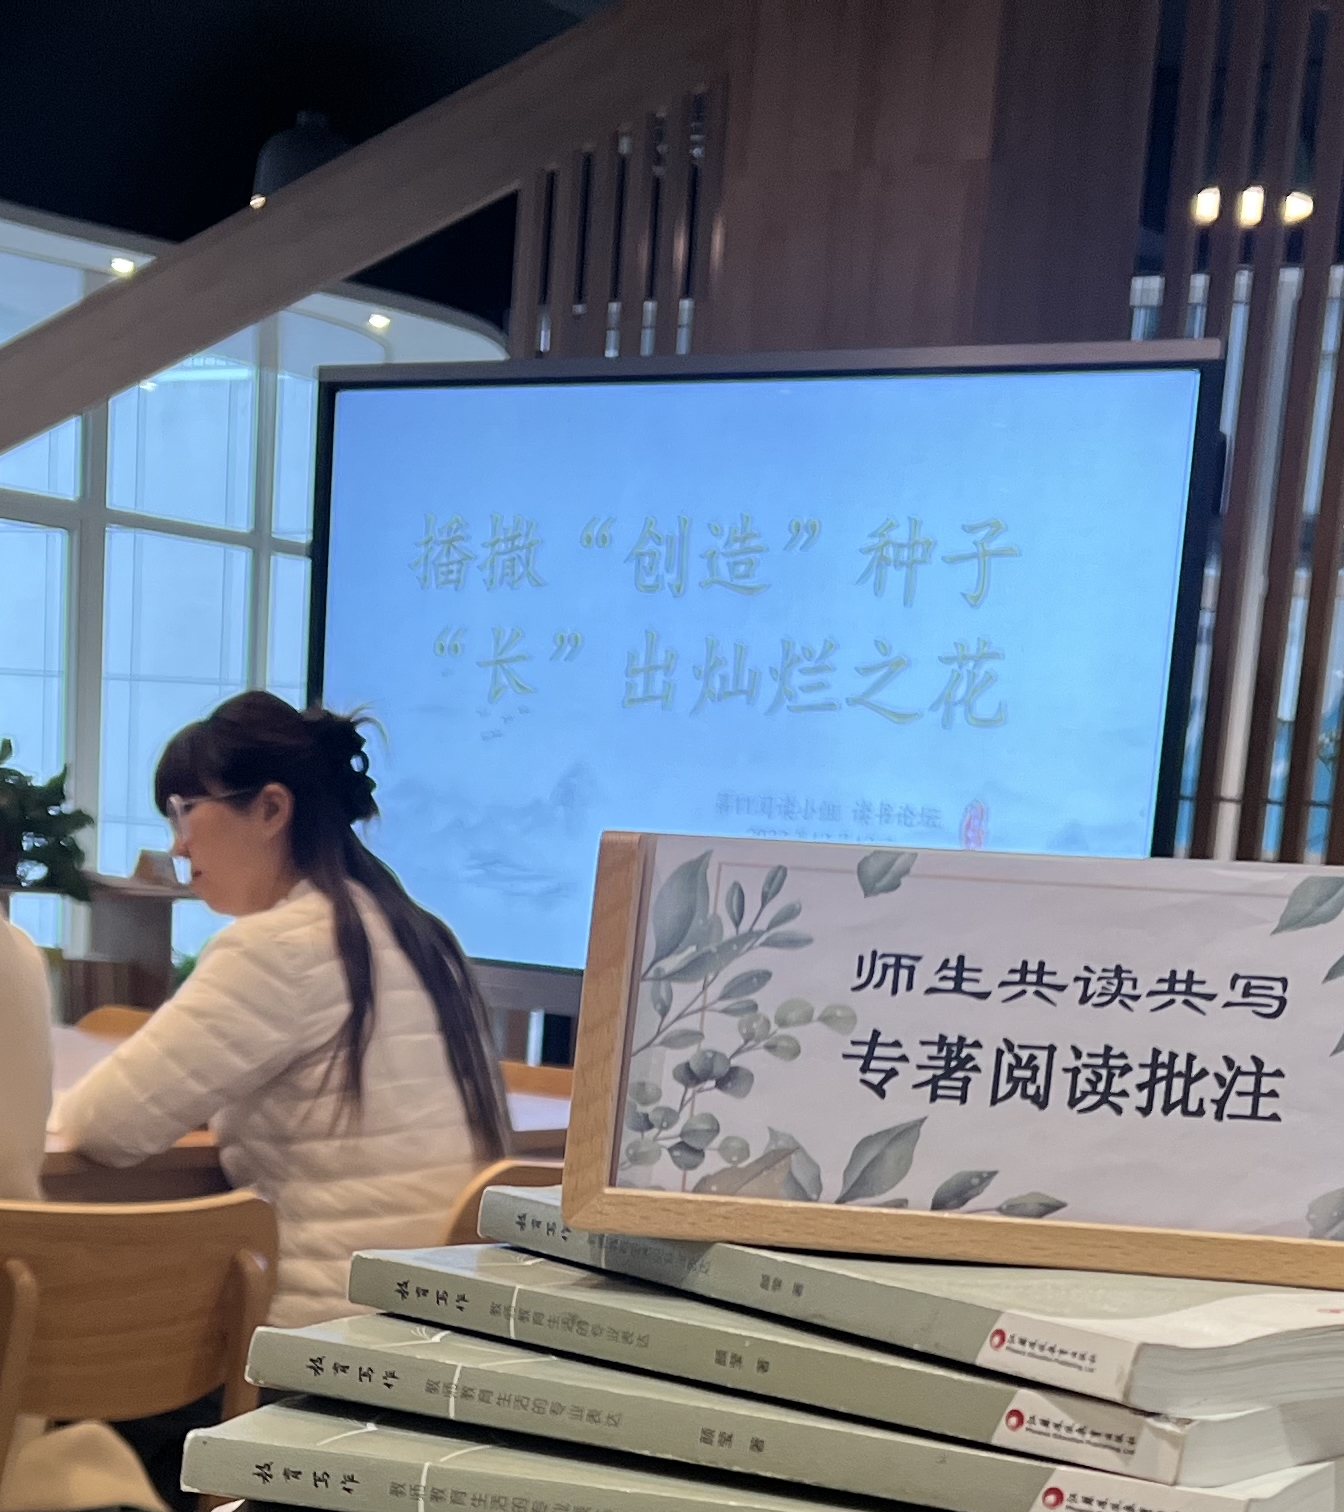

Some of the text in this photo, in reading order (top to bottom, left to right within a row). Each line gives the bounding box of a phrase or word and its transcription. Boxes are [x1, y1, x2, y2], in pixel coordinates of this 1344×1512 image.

[853, 950, 1290, 1017] 师生共读共写
[843, 1029, 1286, 1122] 专著阅读批注
